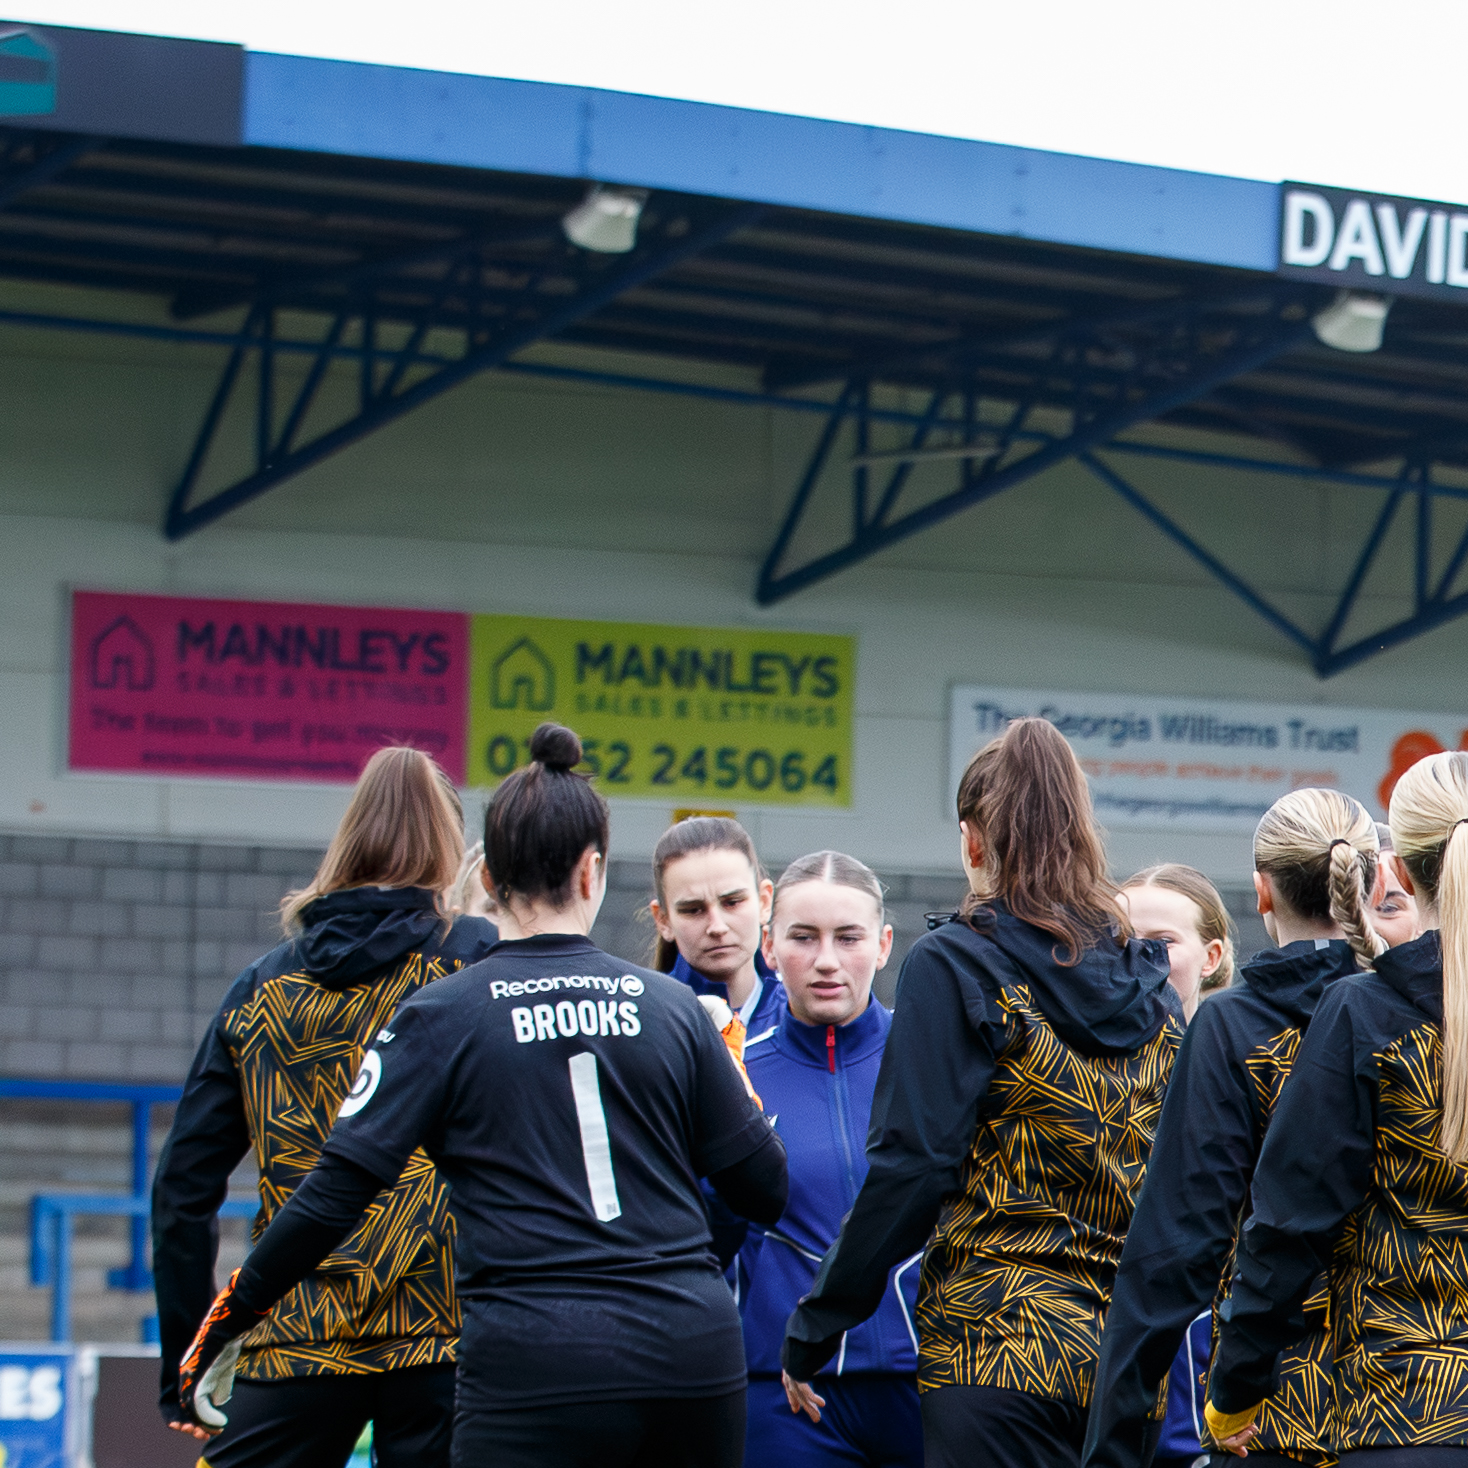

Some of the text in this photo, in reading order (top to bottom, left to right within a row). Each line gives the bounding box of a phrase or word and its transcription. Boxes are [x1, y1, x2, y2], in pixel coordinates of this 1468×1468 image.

[177, 619, 450, 676] MANNLEYS
[574, 640, 841, 699] MANNLEYS
[1159, 712, 1278, 747] Williams
[1287, 719, 1361, 755] Trust
[650, 742, 838, 797] 245064
[489, 974, 621, 1000] Reconomy
[511, 999, 642, 1044] BROOKS
[568, 1051, 622, 1222] 1
